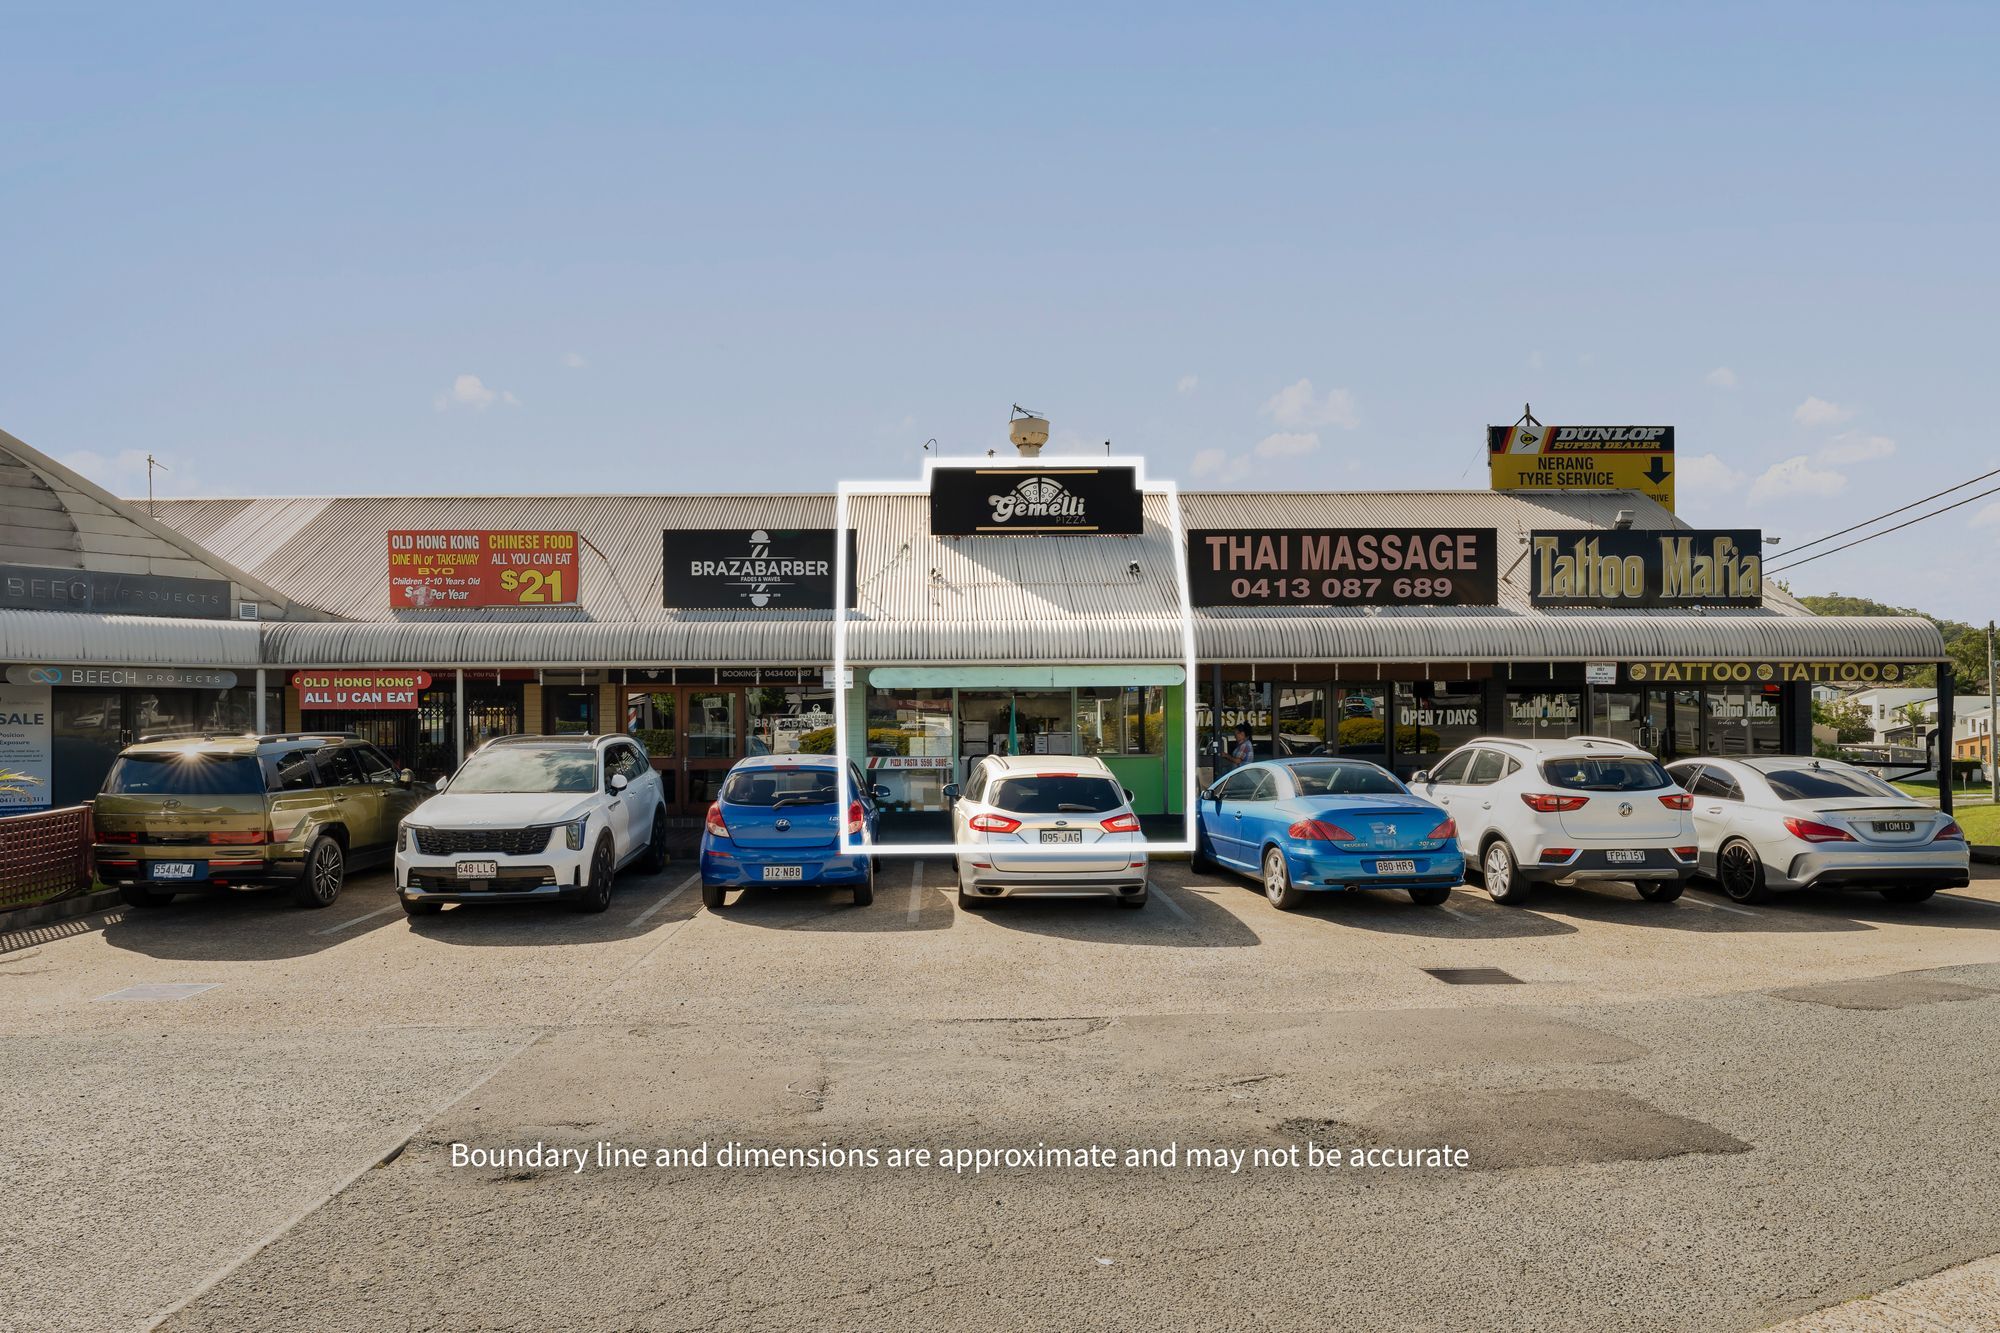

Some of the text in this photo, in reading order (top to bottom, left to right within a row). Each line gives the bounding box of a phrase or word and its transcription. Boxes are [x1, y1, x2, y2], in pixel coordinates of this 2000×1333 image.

[1557, 427, 1665, 440] DUNLOP
[1603, 441, 1661, 449] DEALER
[1538, 457, 1594, 470] NERANG
[1518, 472, 1614, 486] TYRE SERVICE
[1648, 494, 1669, 502] RIVE
[988, 494, 1086, 523] Gemelli
[1056, 516, 1087, 524] PIZZA
[391, 535, 480, 549] OLD HONG KONG
[489, 535, 573, 549] CHINESE FOOD
[392, 554, 480, 565] DINE IN or TAKEAWAY
[491, 553, 572, 564] ALL YOU CAN EAT
[1206, 535, 1477, 571] THAI MASSAGE
[691, 561, 828, 575] BRAZABARBER
[1533, 535, 1762, 599] Tattoo Mafia
[8, 576, 219, 604] BEECH PROJECTS
[500, 568, 562, 602] $21
[1231, 578, 1452, 598] 0413 087 689
[430, 589, 447, 599] Per
[448, 589, 469, 600] Year
[72, 669, 221, 684] BEECH PROJECTS
[1651, 663, 1751, 681] TATTOO
[1779, 663, 1879, 681] TATTOO
[303, 678, 330, 687] OLD
[334, 678, 372, 687] HONG
[376, 678, 414, 687] KONG
[305, 692, 414, 703] ALL U CAN EAT
[1711, 701, 1776, 717] Tattoo Mafia
[0, 713, 44, 725] SALE
[1401, 708, 1478, 726] OPEN 7 DAYS
[905, 758, 917, 766] PASTA
